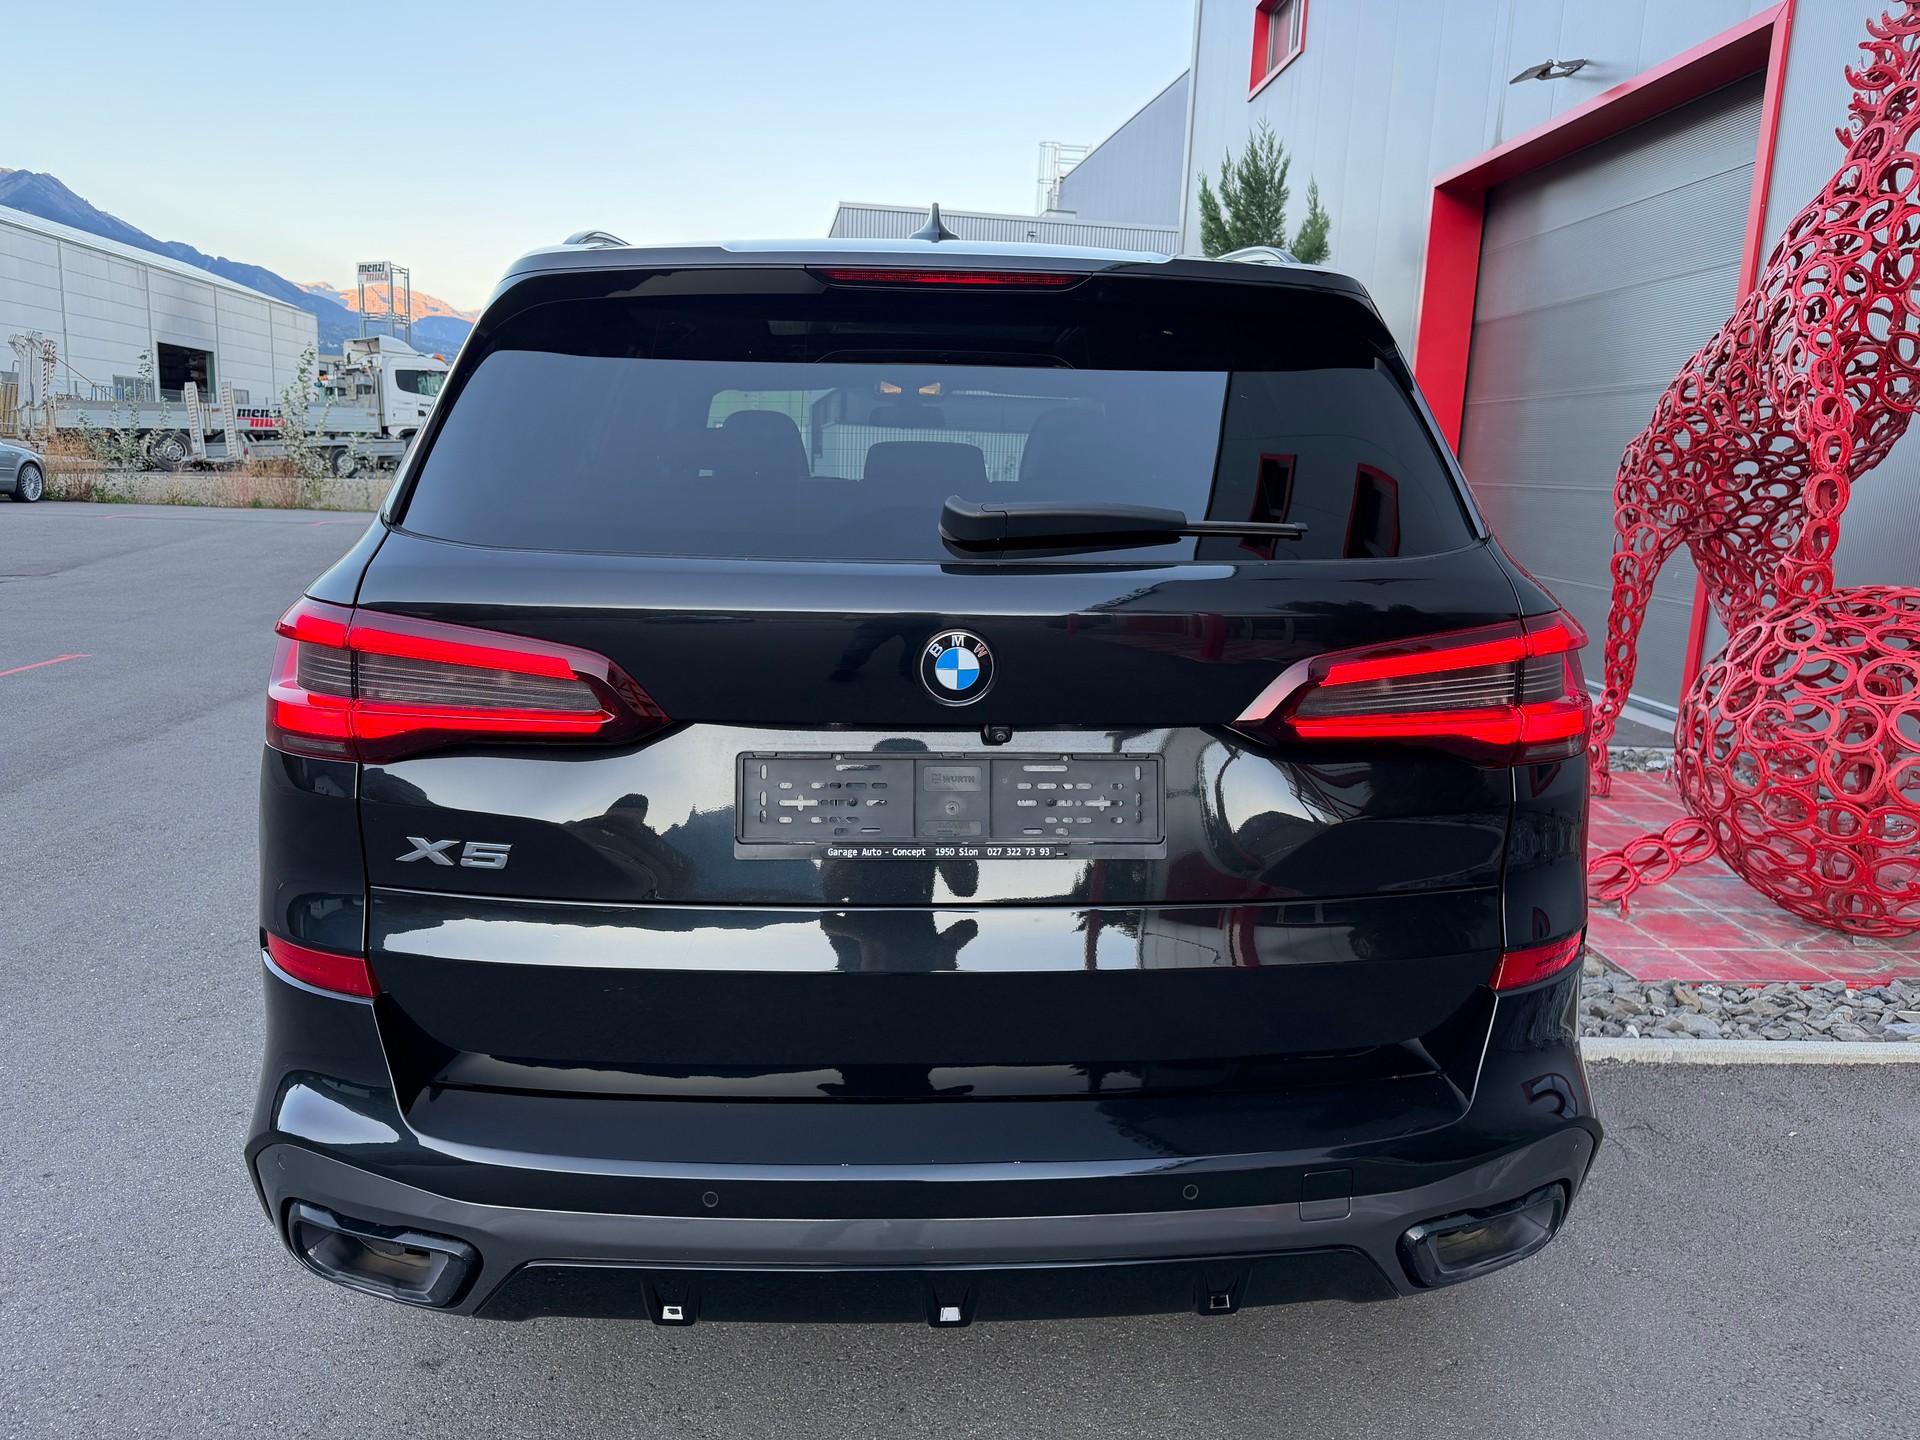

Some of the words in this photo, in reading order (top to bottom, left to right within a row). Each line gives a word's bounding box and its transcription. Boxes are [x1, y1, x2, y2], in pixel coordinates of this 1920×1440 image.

[358, 262, 385, 273] menzi
[929, 635, 988, 658] BMW
[396, 837, 512, 870] X5
[828, 848, 858, 857] Garage
[862, 848, 882, 856] Auto
[892, 848, 926, 857] Concept
[935, 848, 955, 856] 1950
[959, 848, 979, 856] Sion
[987, 848, 1002, 856] 027
[1006, 848, 1023, 856] 322
[1025, 848, 1036, 856] 73
[1039, 848, 1050, 856] 93
